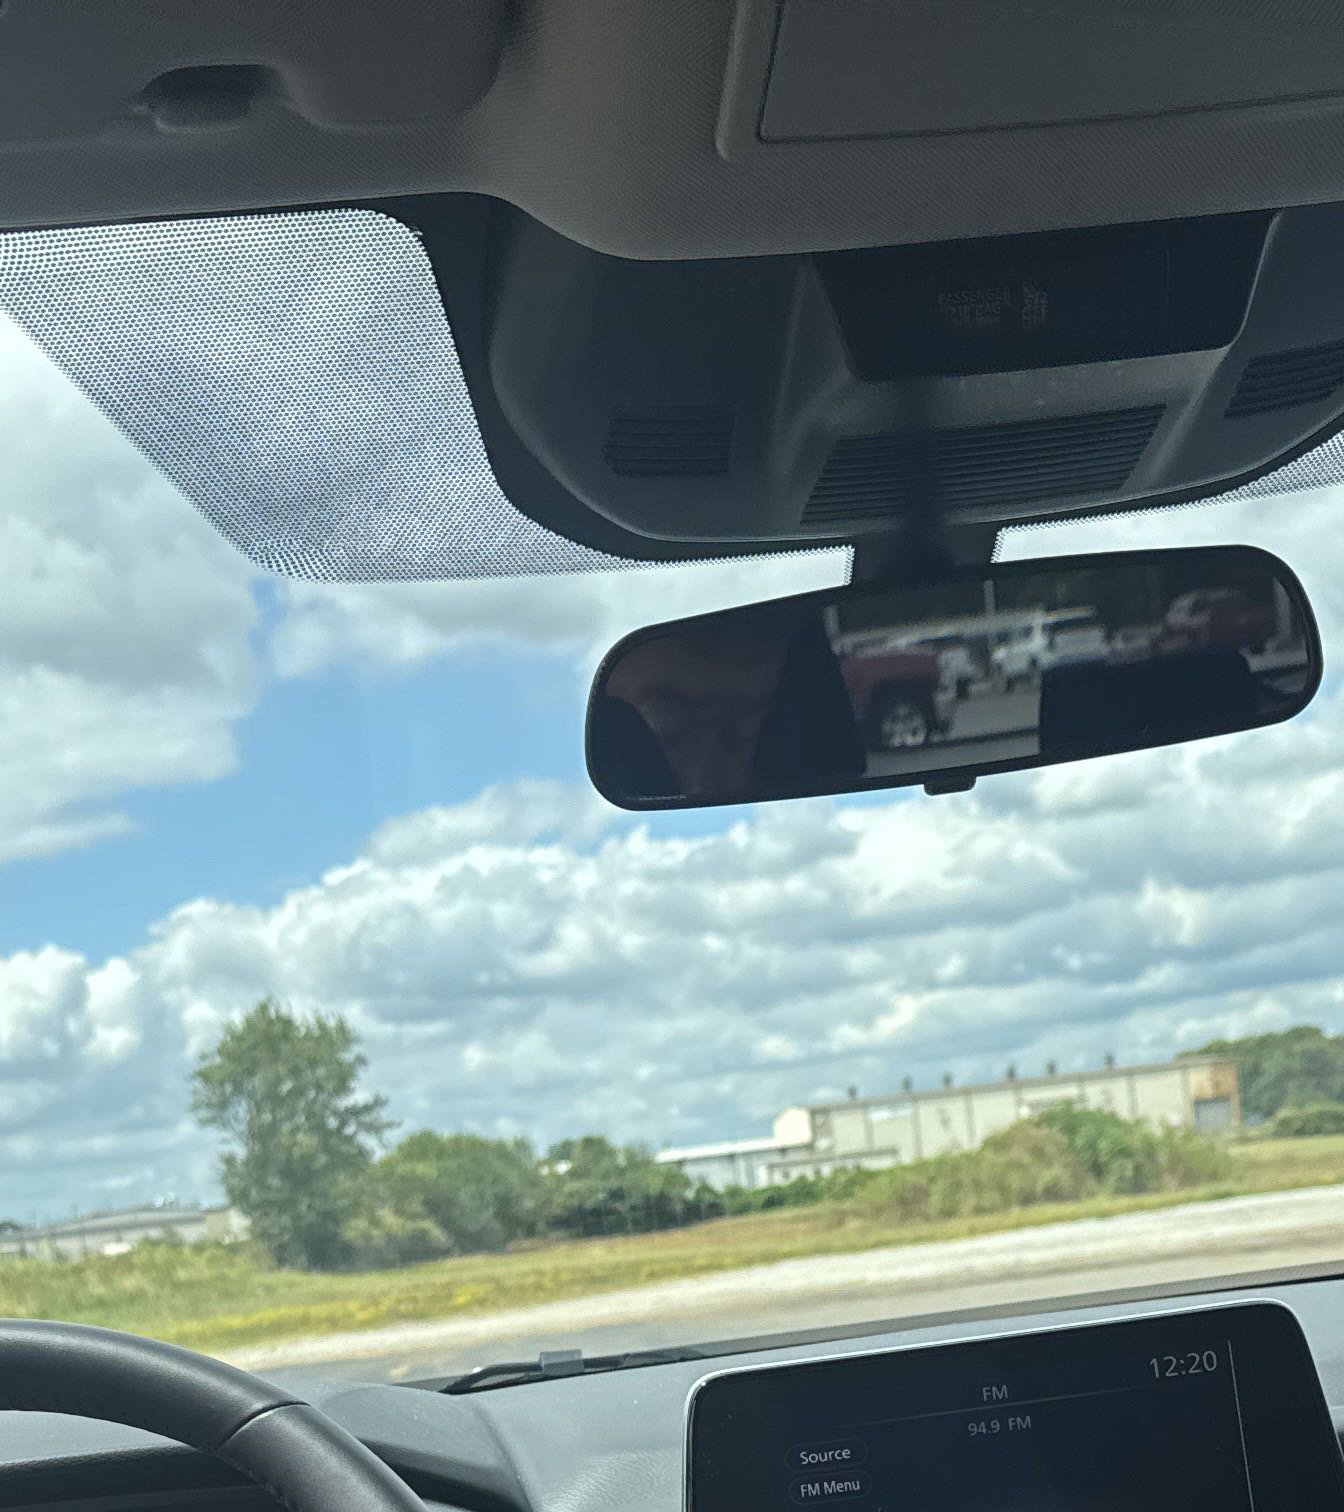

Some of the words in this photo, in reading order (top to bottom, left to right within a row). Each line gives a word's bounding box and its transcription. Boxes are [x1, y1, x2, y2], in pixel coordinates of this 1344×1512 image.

[1150, 1350, 1217, 1379] 12:20
[982, 1385, 1008, 1401] FM
[968, 1420, 1000, 1436] 94.9
[1008, 1416, 1032, 1431] FM
[799, 1448, 851, 1465] Source
[800, 1482, 821, 1498] FM
[823, 1479, 861, 1495] Menu
